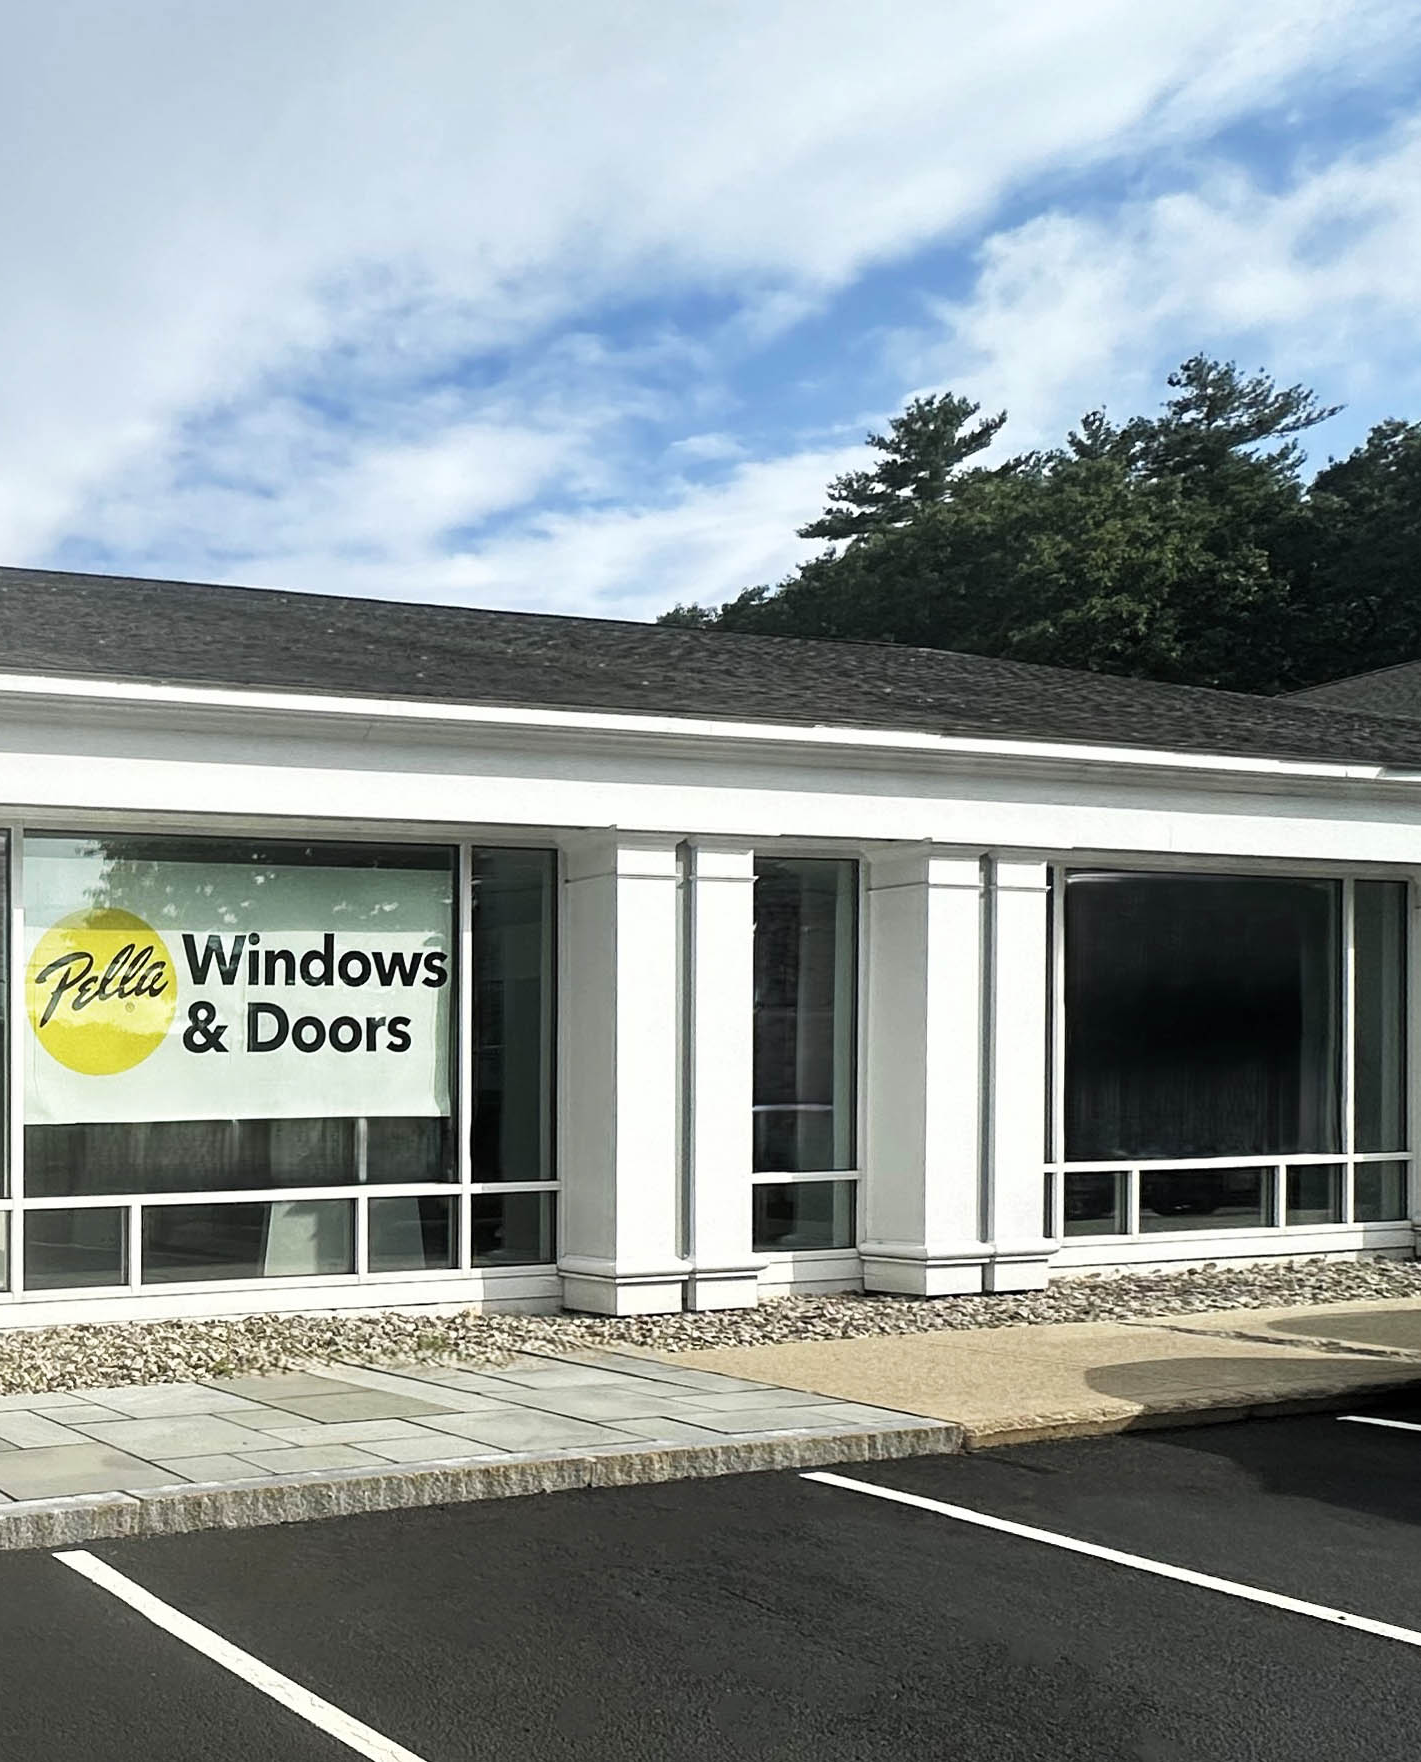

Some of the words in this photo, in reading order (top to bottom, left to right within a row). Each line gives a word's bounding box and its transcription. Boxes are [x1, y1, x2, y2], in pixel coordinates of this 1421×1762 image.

[35, 943, 170, 1028] Pella
[181, 932, 449, 989] Windows
[182, 1001, 229, 1054] &
[246, 1002, 412, 1054] Doors
